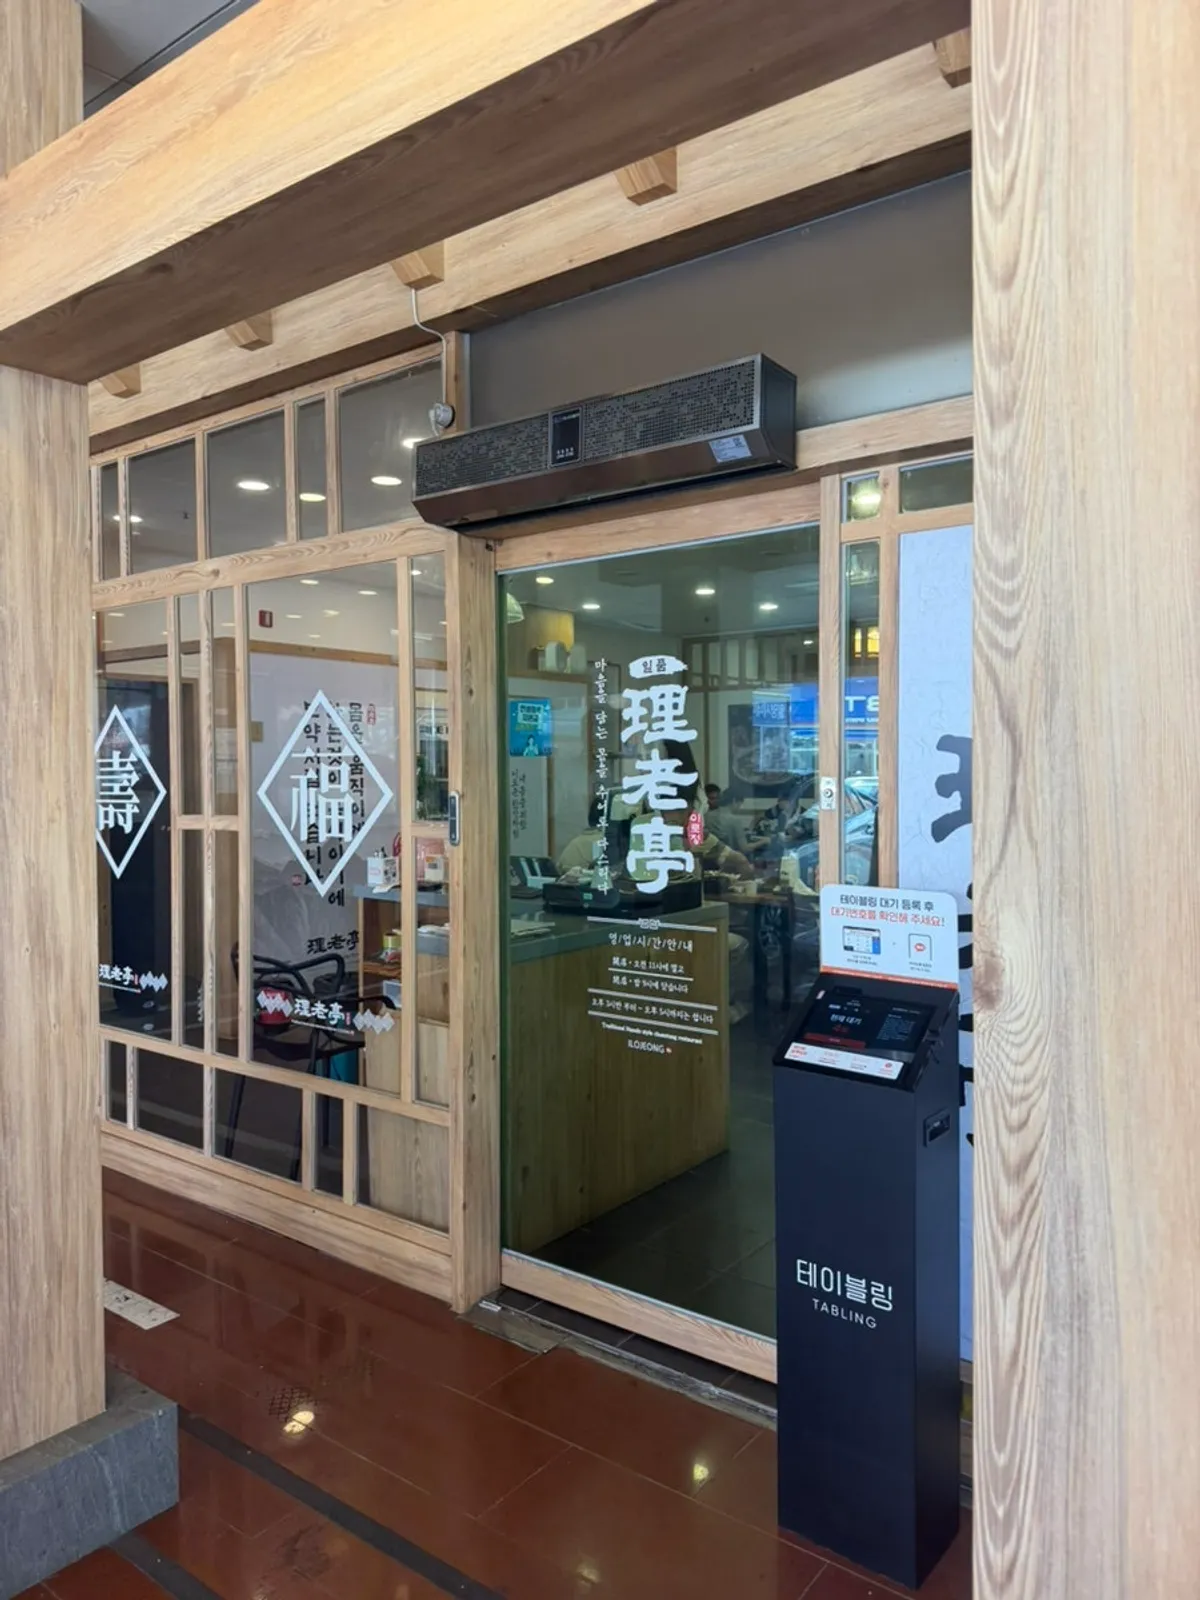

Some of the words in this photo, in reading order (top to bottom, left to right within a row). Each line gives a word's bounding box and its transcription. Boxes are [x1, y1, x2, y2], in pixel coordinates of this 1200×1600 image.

[594, 657, 608, 704] 마음을
[642, 658, 667, 674] 일품
[289, 745, 357, 843] 福
[620, 684, 699, 895] 理老亭
[831, 907, 876, 920] 대기번호를
[879, 911, 908, 924] 확인해
[911, 913, 945, 927] 주세요!
[840, 894, 877, 908] 테이블링
[880, 896, 899, 909] 대기
[902, 898, 923, 911] 등록
[924, 899, 934, 912] 후
[294, 998, 345, 1025] 理老亭
[627, 1039, 665, 1054] ILOJEONG
[796, 1259, 893, 1312] 테이블링
[812, 1297, 877, 1329] TABLING
